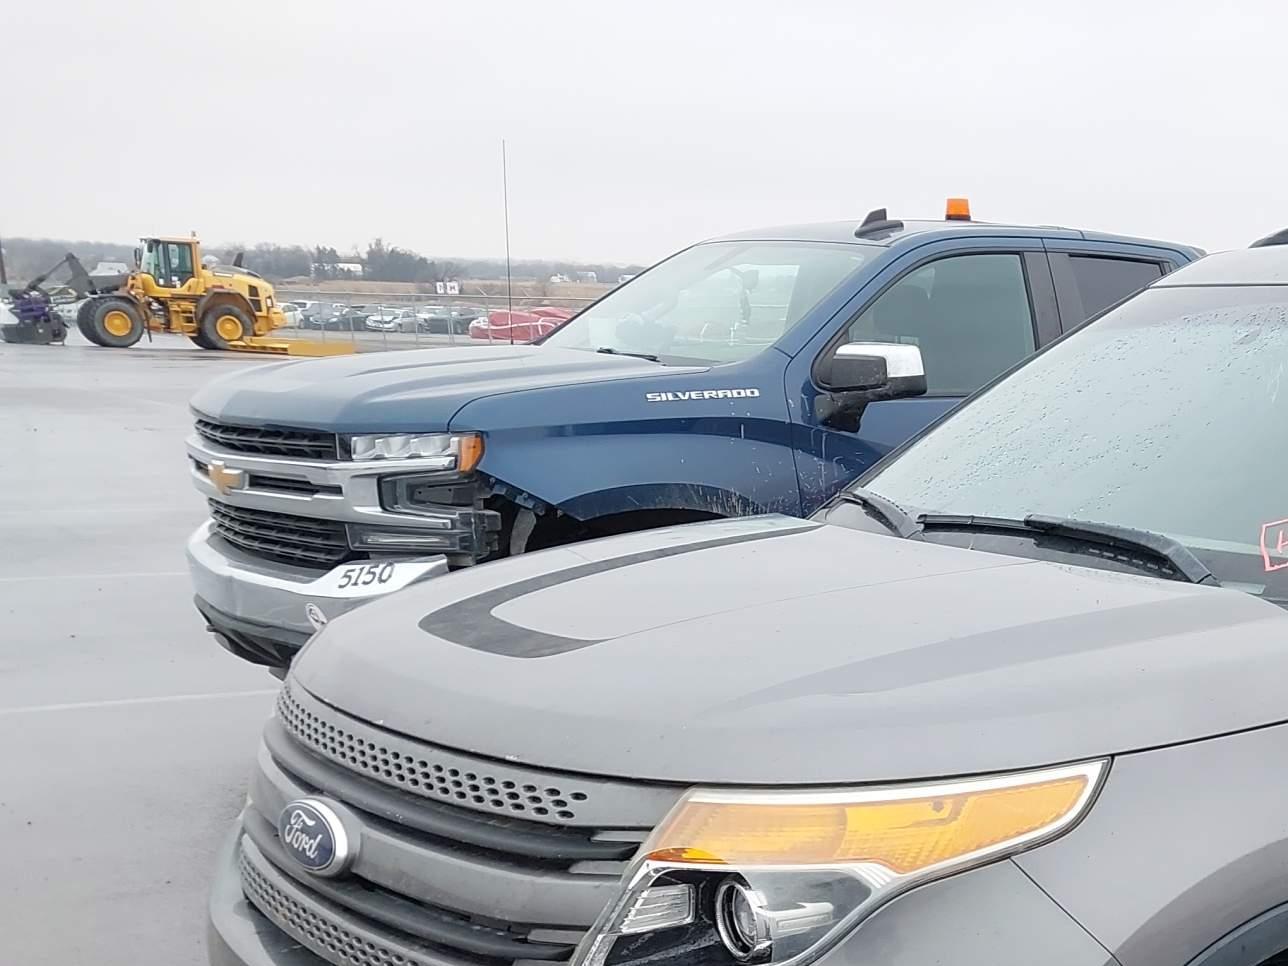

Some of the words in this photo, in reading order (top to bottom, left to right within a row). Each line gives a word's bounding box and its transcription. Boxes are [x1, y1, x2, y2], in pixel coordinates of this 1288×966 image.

[646, 388, 760, 402] SILVERADO
[338, 561, 395, 589] 5150
[285, 809, 322, 859] Ford
